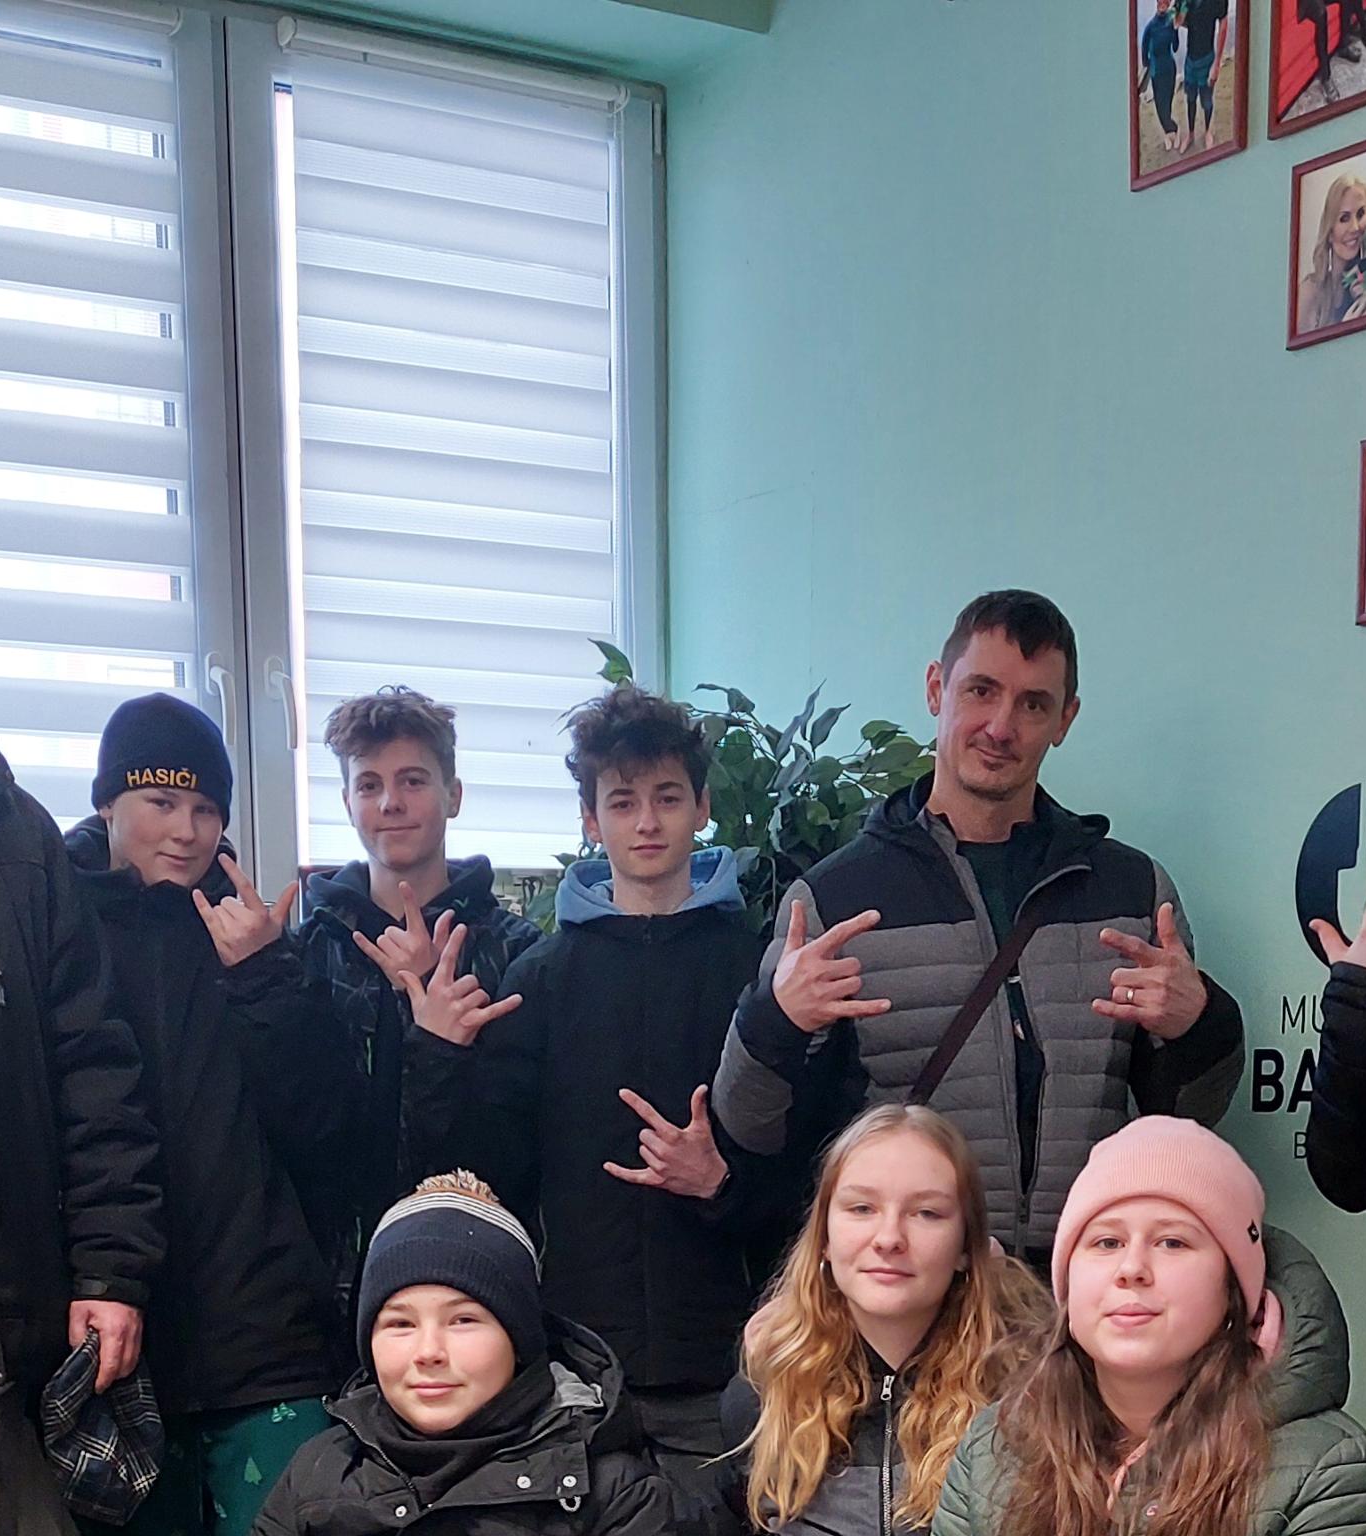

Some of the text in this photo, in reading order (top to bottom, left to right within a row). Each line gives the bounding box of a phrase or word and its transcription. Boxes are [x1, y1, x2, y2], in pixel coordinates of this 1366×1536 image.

[126, 767, 197, 789] HASIČI
[1281, 995, 1325, 1035] MU
[1251, 1048, 1317, 1113] BA
[1293, 1131, 1308, 1160] B
